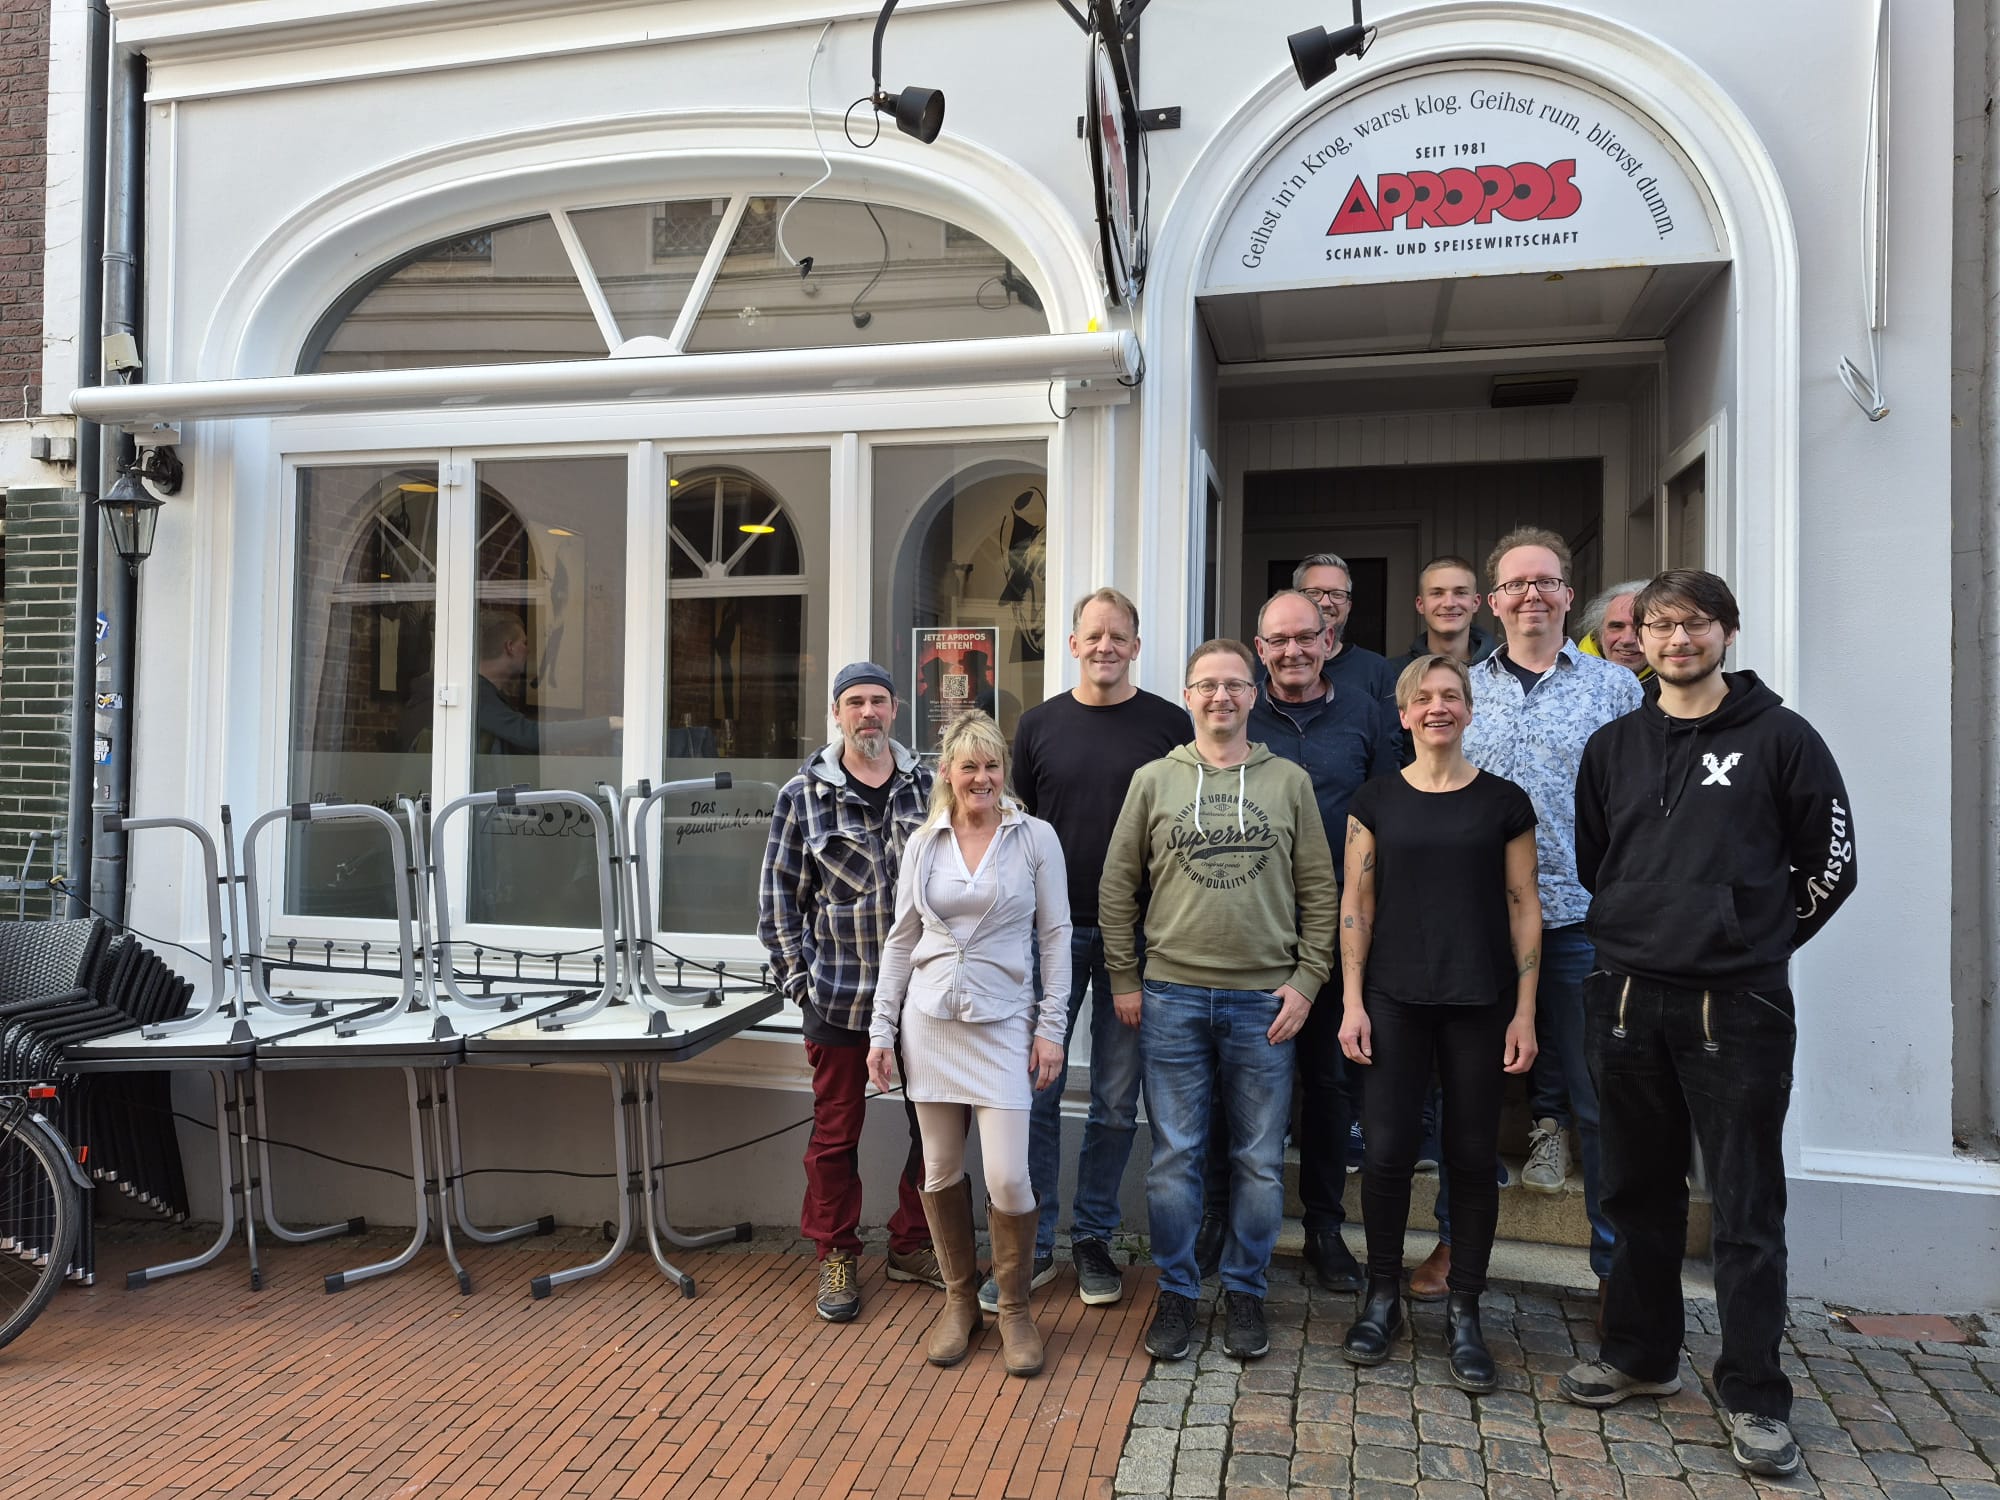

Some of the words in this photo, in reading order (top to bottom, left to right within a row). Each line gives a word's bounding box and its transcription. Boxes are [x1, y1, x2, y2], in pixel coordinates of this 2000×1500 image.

[1415, 146, 1446, 159] SEIT
[1454, 142, 1486, 156] 1981
[1241, 209, 1282, 268] Geihst
[1301, 137, 1352, 175] Krog,
[1353, 104, 1410, 138] warst
[1415, 95, 1461, 115] klog.
[1470, 90, 1535, 116] Geihst
[1539, 103, 1581, 135] rum,
[1586, 123, 1644, 177] blievst
[1636, 176, 1675, 241] dumm.
[1325, 158, 1583, 236] APROPOS
[1325, 246, 1389, 261] SCHANK-
[1396, 242, 1427, 255] UND
[1434, 231, 1579, 253] SPEISEWIRTSCHAFT
[923, 633, 946, 642] JETZT
[947, 633, 986, 641] APROPOS
[935, 641, 973, 650] RETTEN!
[690, 801, 716, 816] Das
[1208, 793, 1240, 804] URBAN
[1242, 798, 1268, 822] BRAND
[1166, 822, 1278, 856] Superior
[1175, 851, 1205, 885] PREMIUM
[1206, 874, 1247, 889] QUALITY
[1247, 854, 1270, 880] DENIM
[1796, 798, 1852, 918] Ansgar
